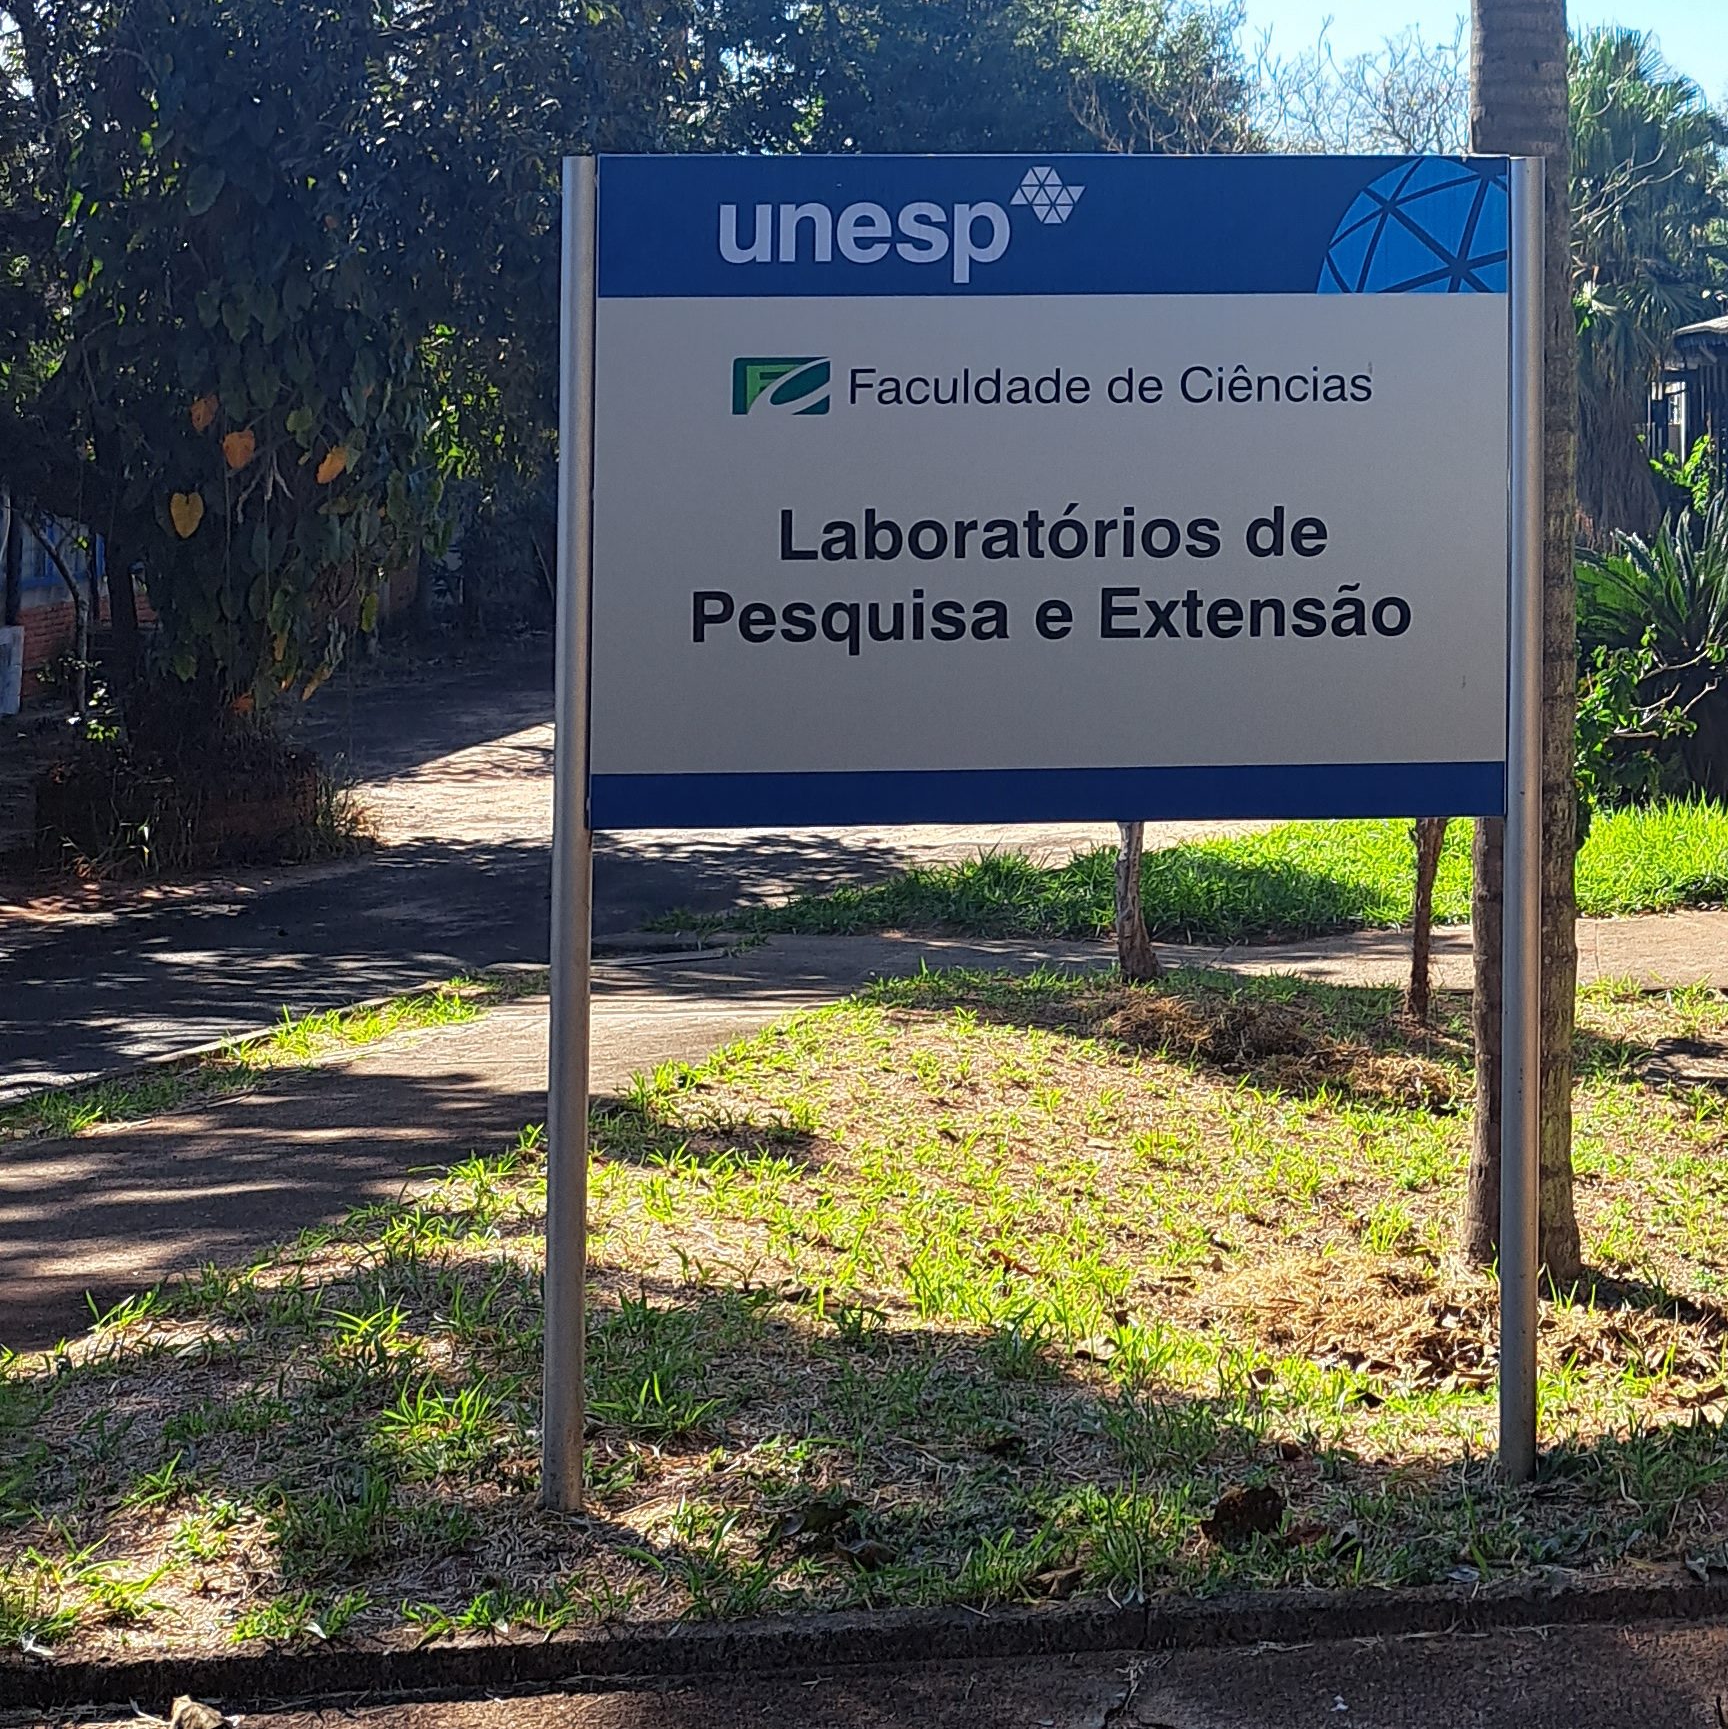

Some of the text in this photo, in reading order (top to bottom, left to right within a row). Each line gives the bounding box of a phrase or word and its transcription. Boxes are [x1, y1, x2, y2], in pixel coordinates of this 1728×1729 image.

[719, 201, 1011, 284] unesp
[850, 364, 1372, 405] Faculdade de Ciências
[780, 502, 1328, 562] Laboratórios de
[692, 582, 1412, 657] Pesquisa e Extensão
